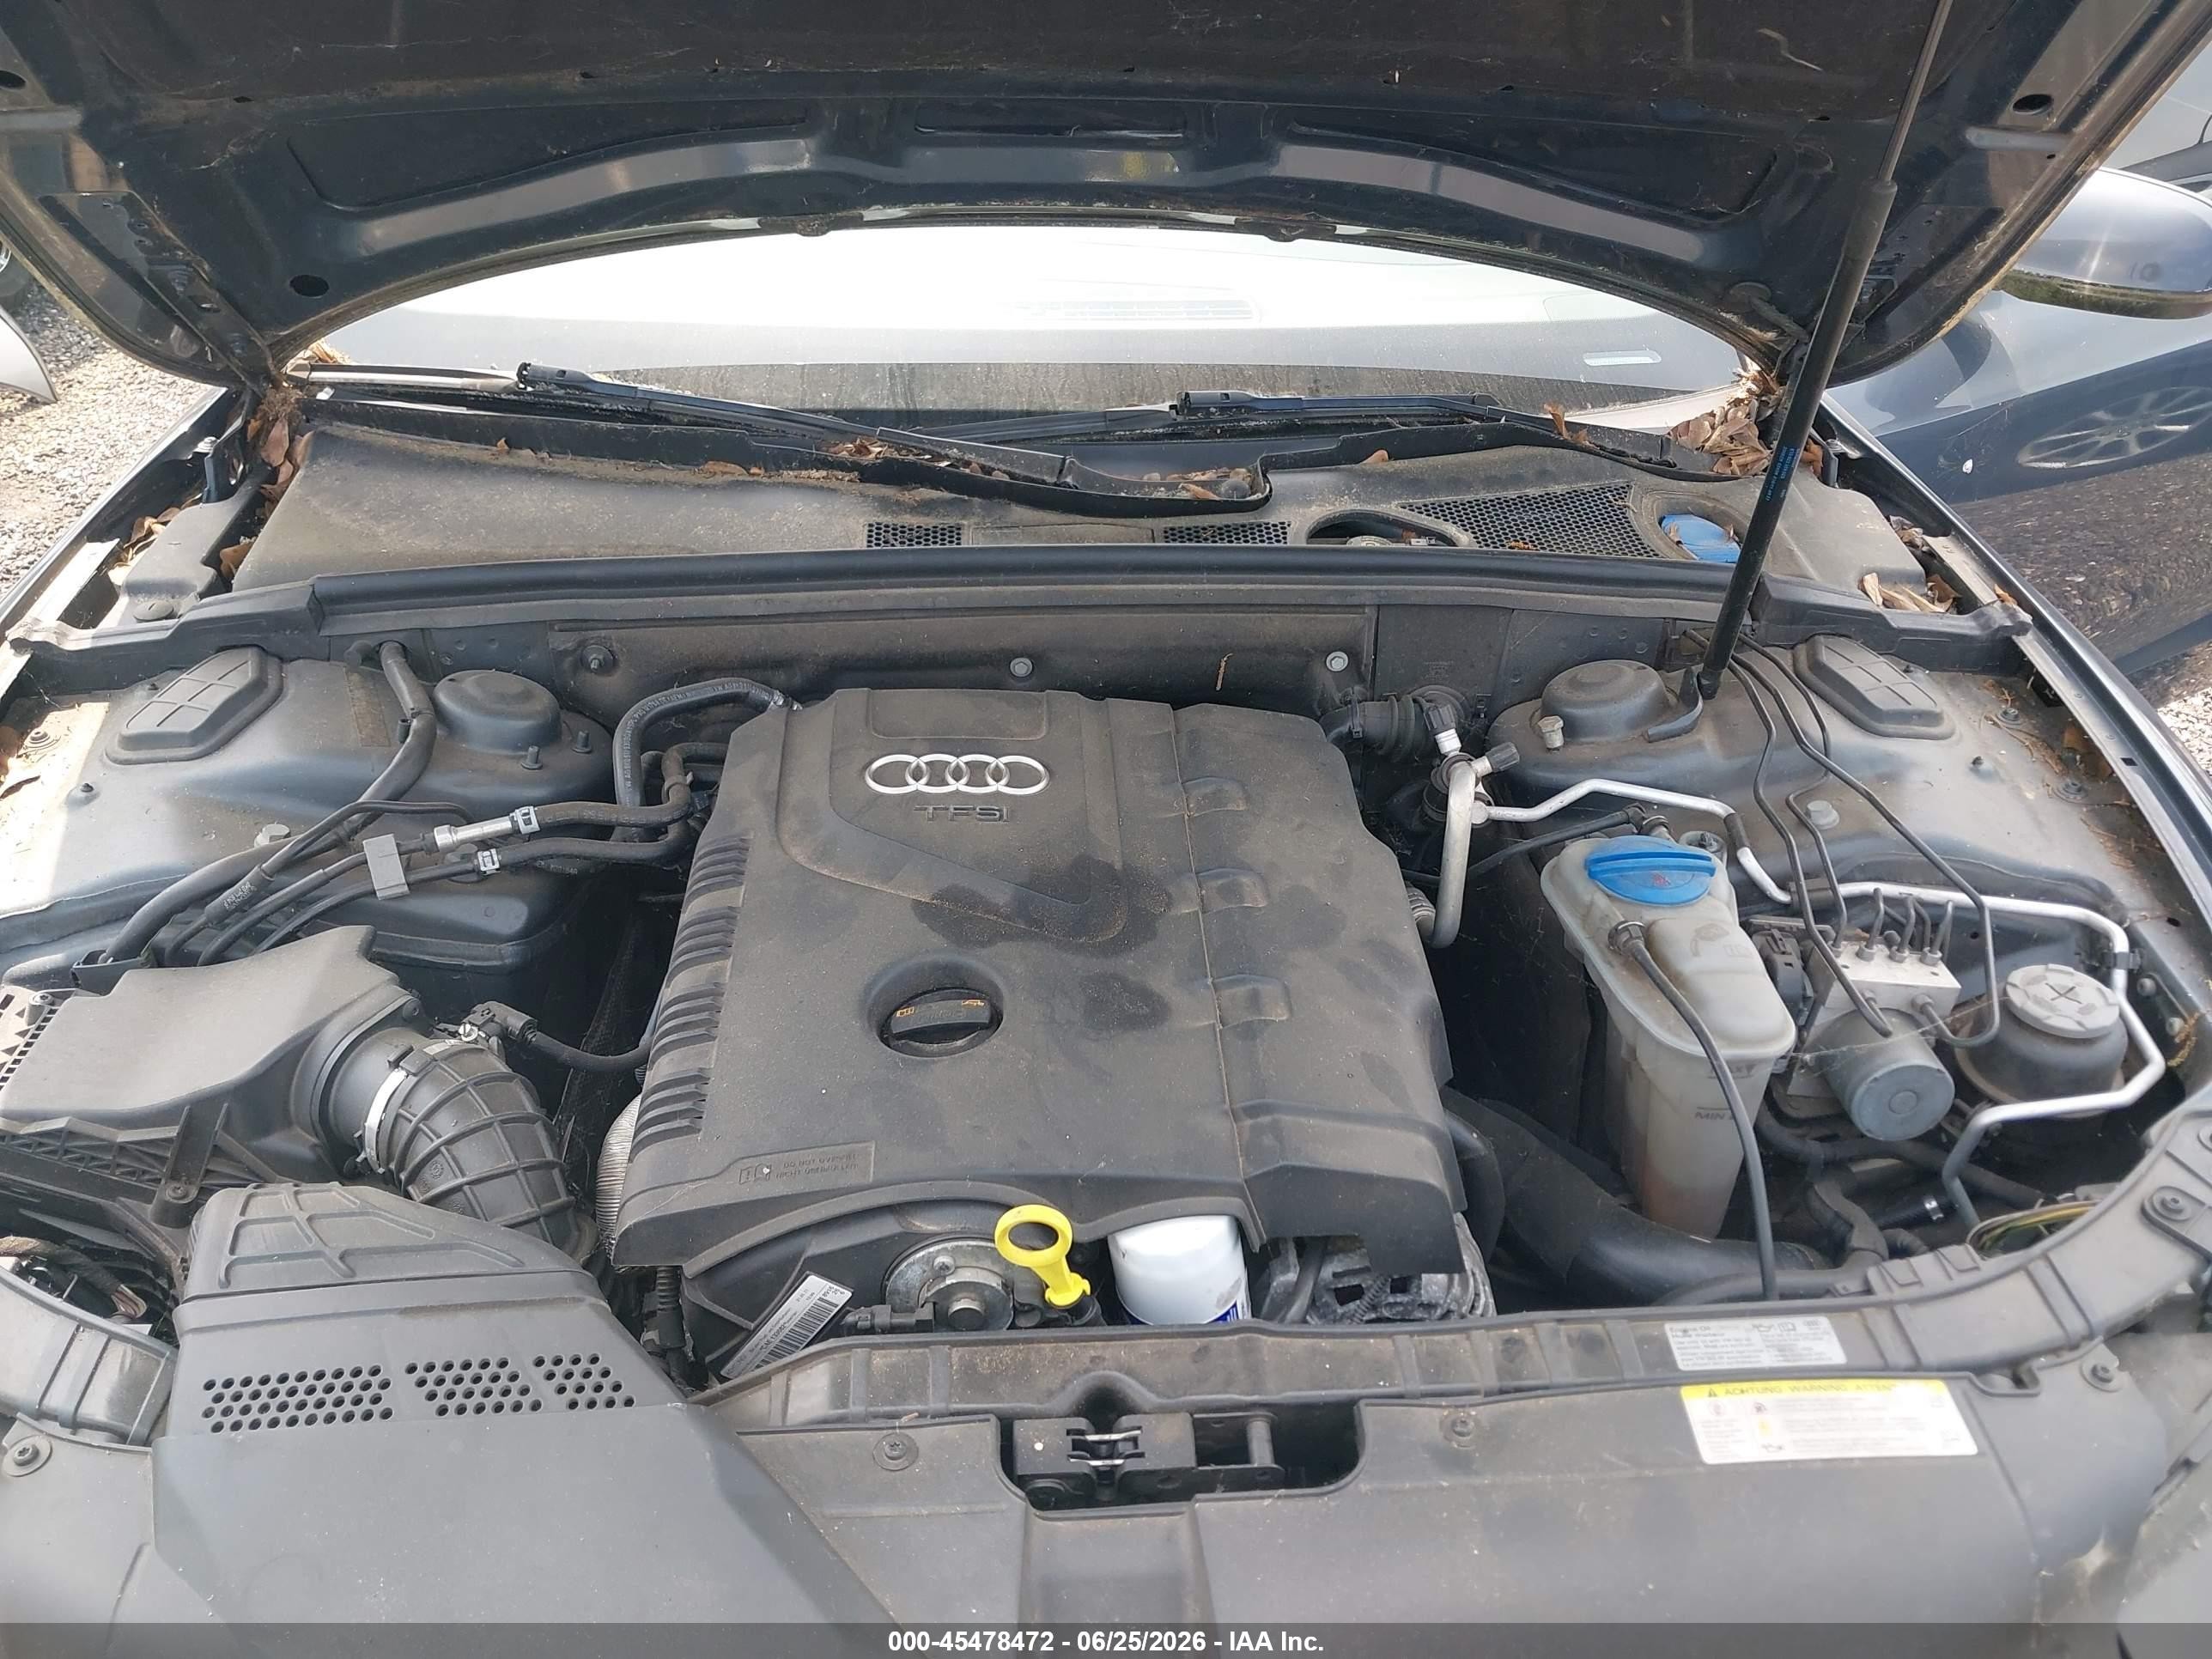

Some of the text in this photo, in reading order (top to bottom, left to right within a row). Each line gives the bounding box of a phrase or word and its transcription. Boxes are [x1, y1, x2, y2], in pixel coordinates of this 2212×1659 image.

[914, 805, 1009, 822] TFSI
[1724, 1385, 1783, 1396] ACHTUNG
[1789, 1383, 1848, 1393] WARNING
